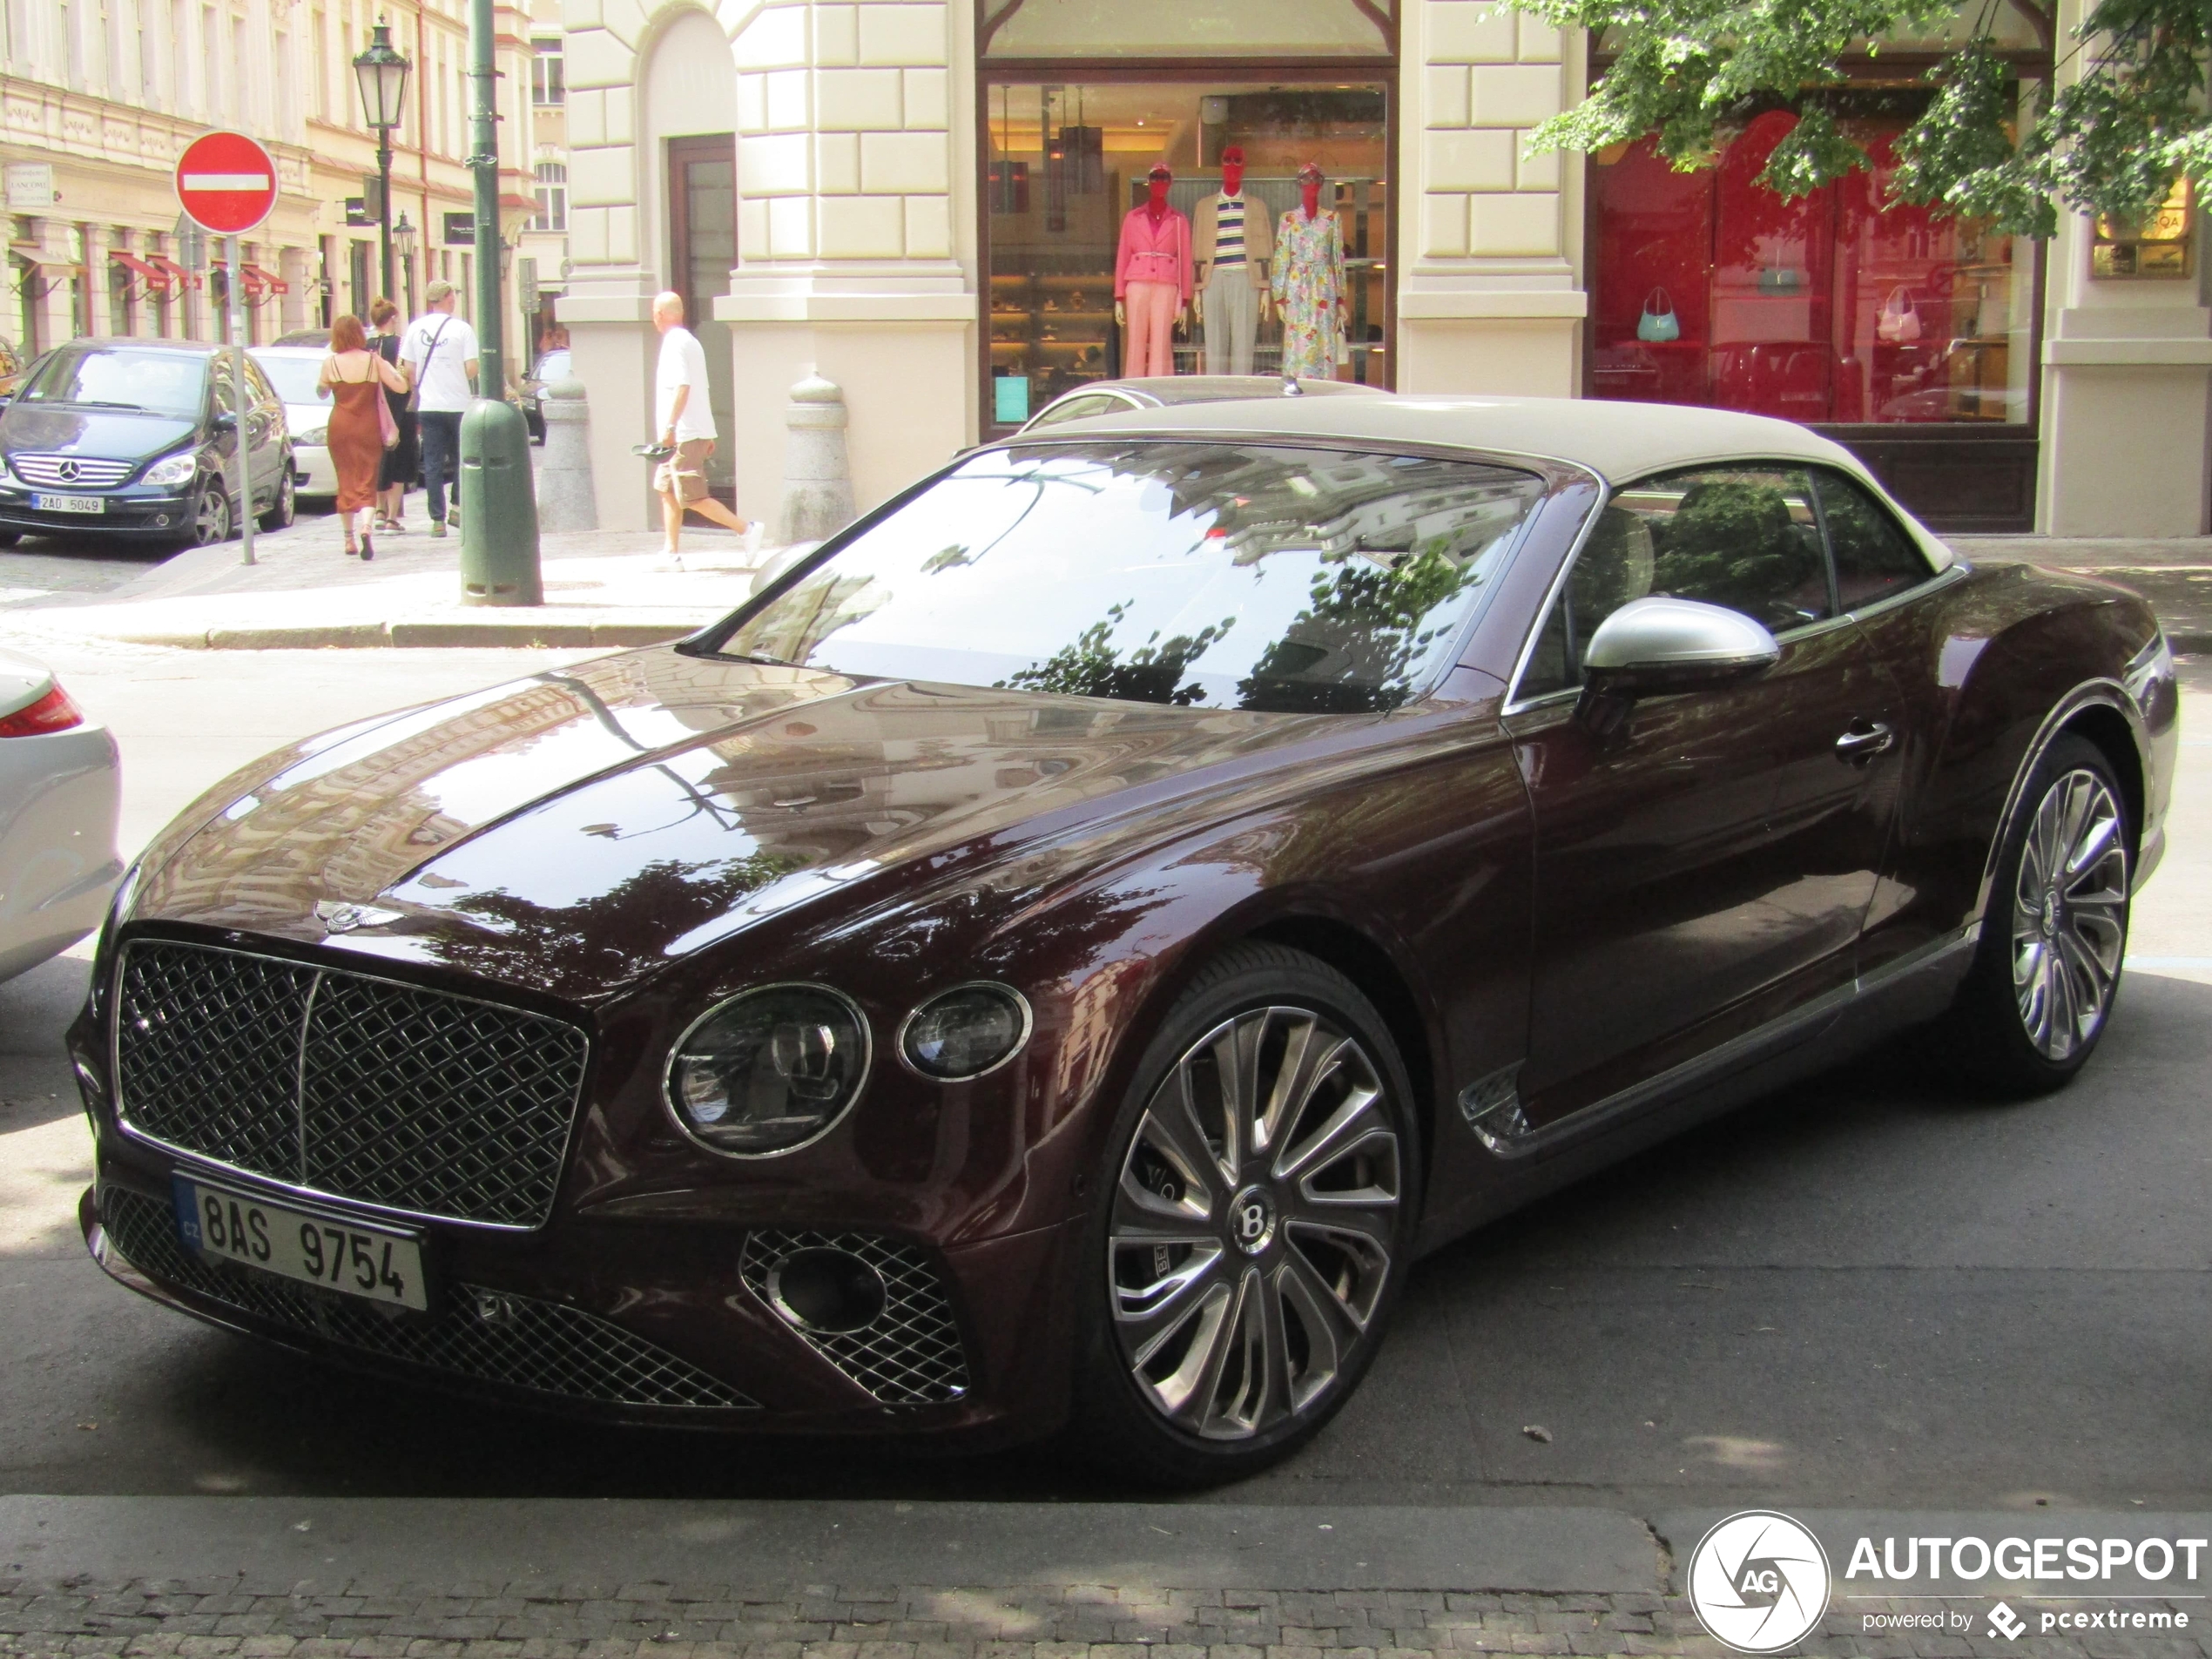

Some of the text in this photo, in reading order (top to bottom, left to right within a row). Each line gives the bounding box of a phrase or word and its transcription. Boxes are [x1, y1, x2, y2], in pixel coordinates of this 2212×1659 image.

[42, 497, 98, 511] 2AD 5049
[183, 1221, 199, 1238] CZ
[1242, 1204, 1264, 1238] B
[205, 1195, 405, 1298] 8AS 9754
[1157, 1245, 1168, 1273] BE
